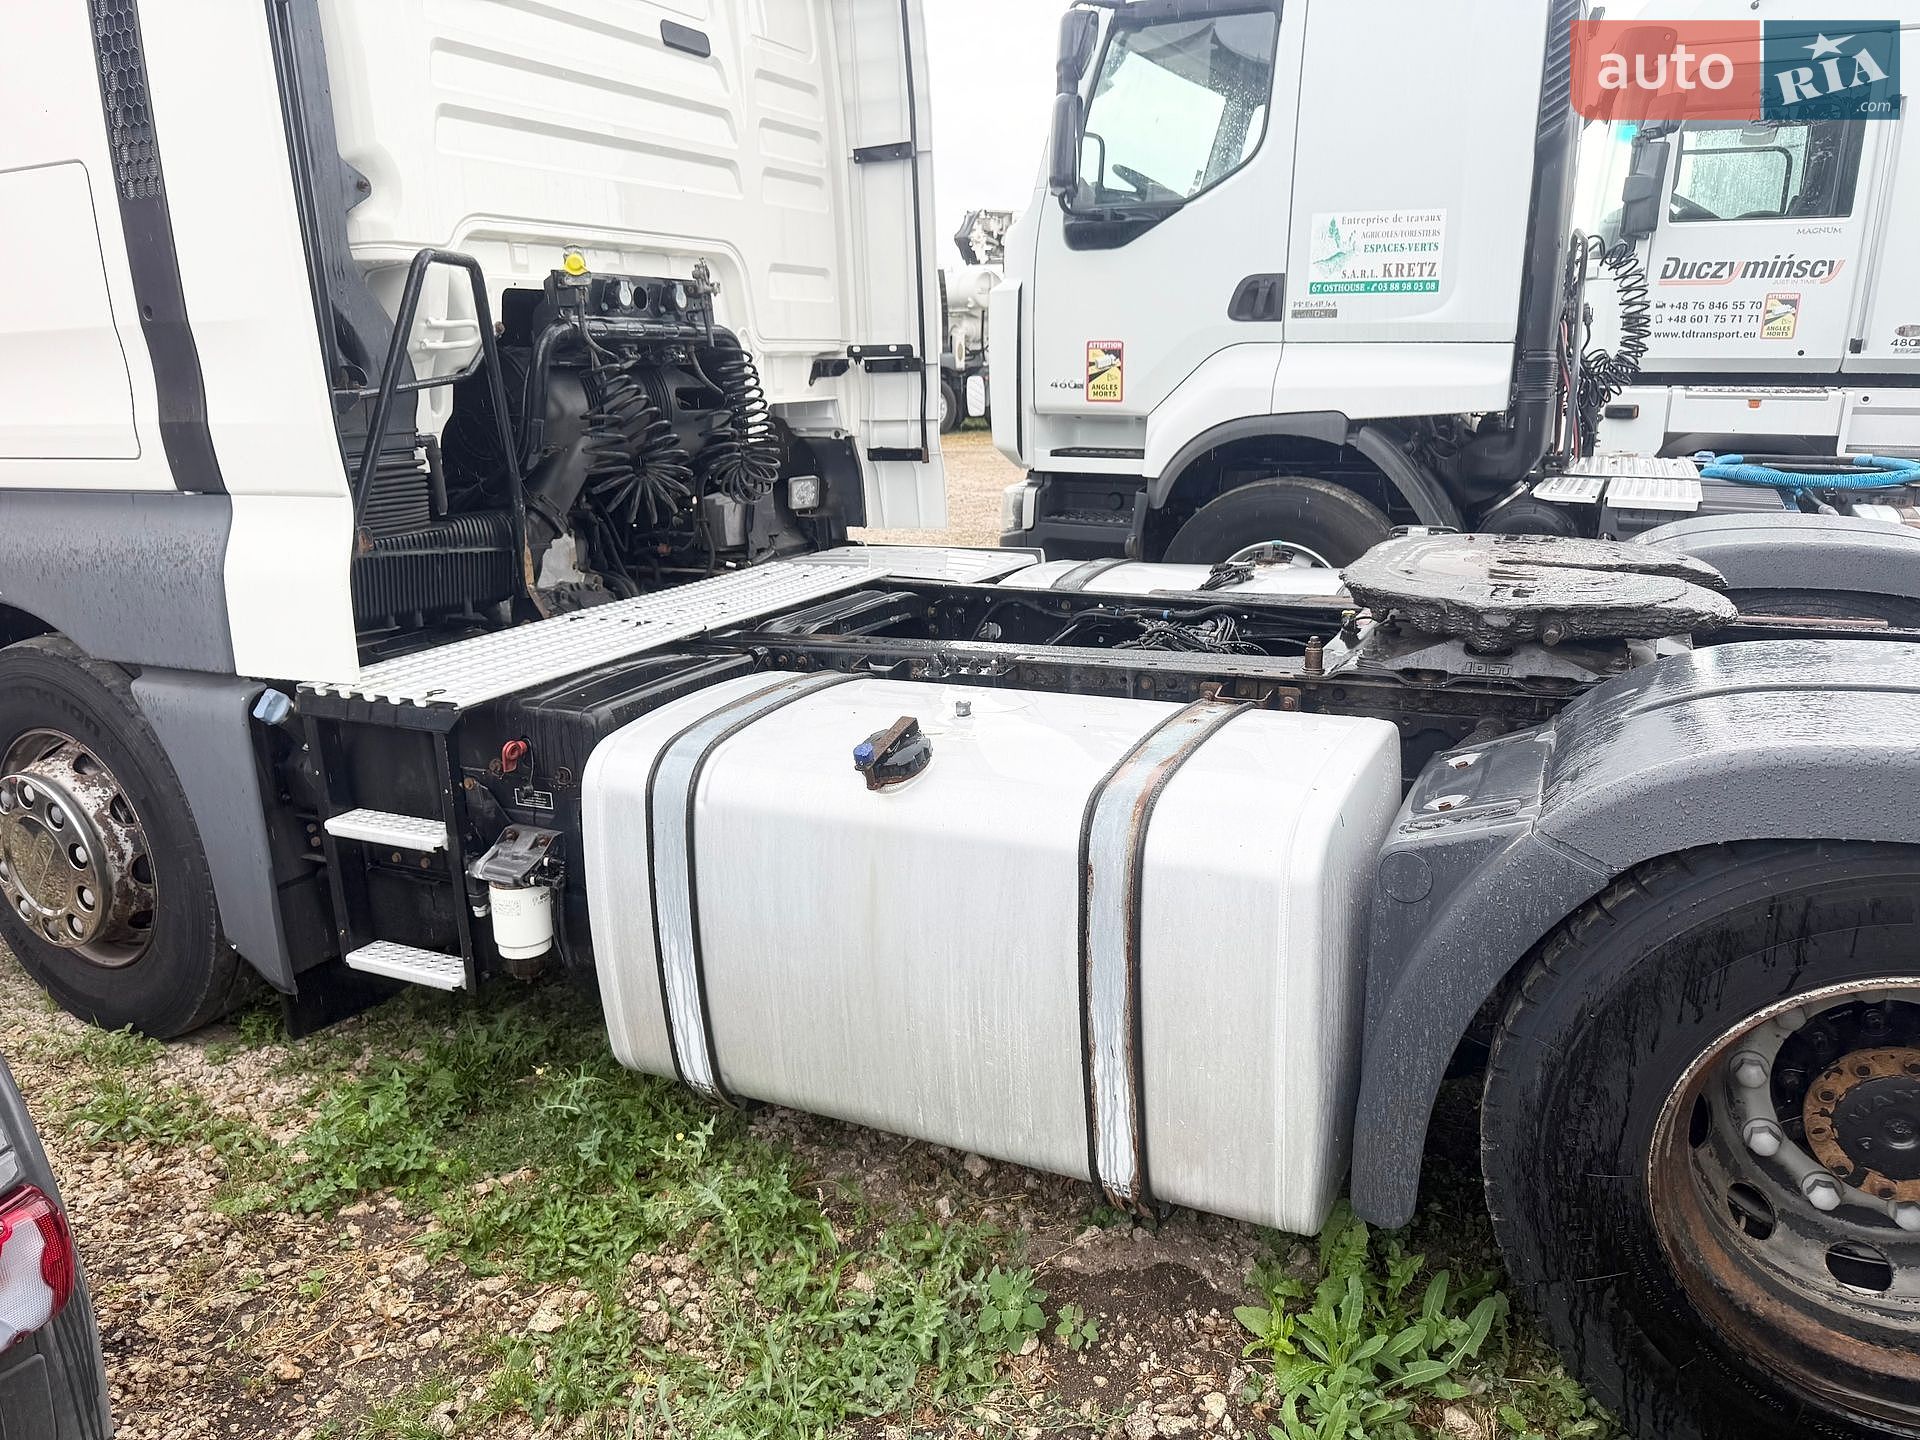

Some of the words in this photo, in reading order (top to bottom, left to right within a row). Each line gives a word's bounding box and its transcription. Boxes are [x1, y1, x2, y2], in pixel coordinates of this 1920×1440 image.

[1342, 214, 1389, 226] Entreprise
[1392, 213, 1403, 223] de
[1406, 213, 1441, 223] travaux
[1796, 226, 1842, 235] MAGNUM
[1363, 242, 1439, 253] ESPACES-VERTS
[1341, 269, 1378, 279] S.A.R.L.
[1382, 262, 1437, 278] KRETZ
[1659, 253, 1846, 286] Duczymińscy
[1311, 283, 1321, 293] 67
[1322, 282, 1365, 293] OSTHOUSE
[1377, 282, 1388, 291] 03
[1389, 282, 1400, 291] 88
[1401, 282, 1411, 291] 98
[1413, 281, 1423, 291] 03
[1425, 281, 1436, 290] 08
[1669, 301, 1688, 310] +48
[1692, 301, 1705, 310] 76
[1708, 301, 1728, 310] 846
[1731, 301, 1745, 310] 55
[1749, 301, 1763, 310] 70
[1668, 315, 1687, 323] +48
[1690, 314, 1708, 323] 601
[1713, 314, 1727, 323] 75
[1731, 314, 1742, 323] 71
[1747, 314, 1759, 323] 71
[1654, 329, 1756, 340] www.tdtransport.eu
